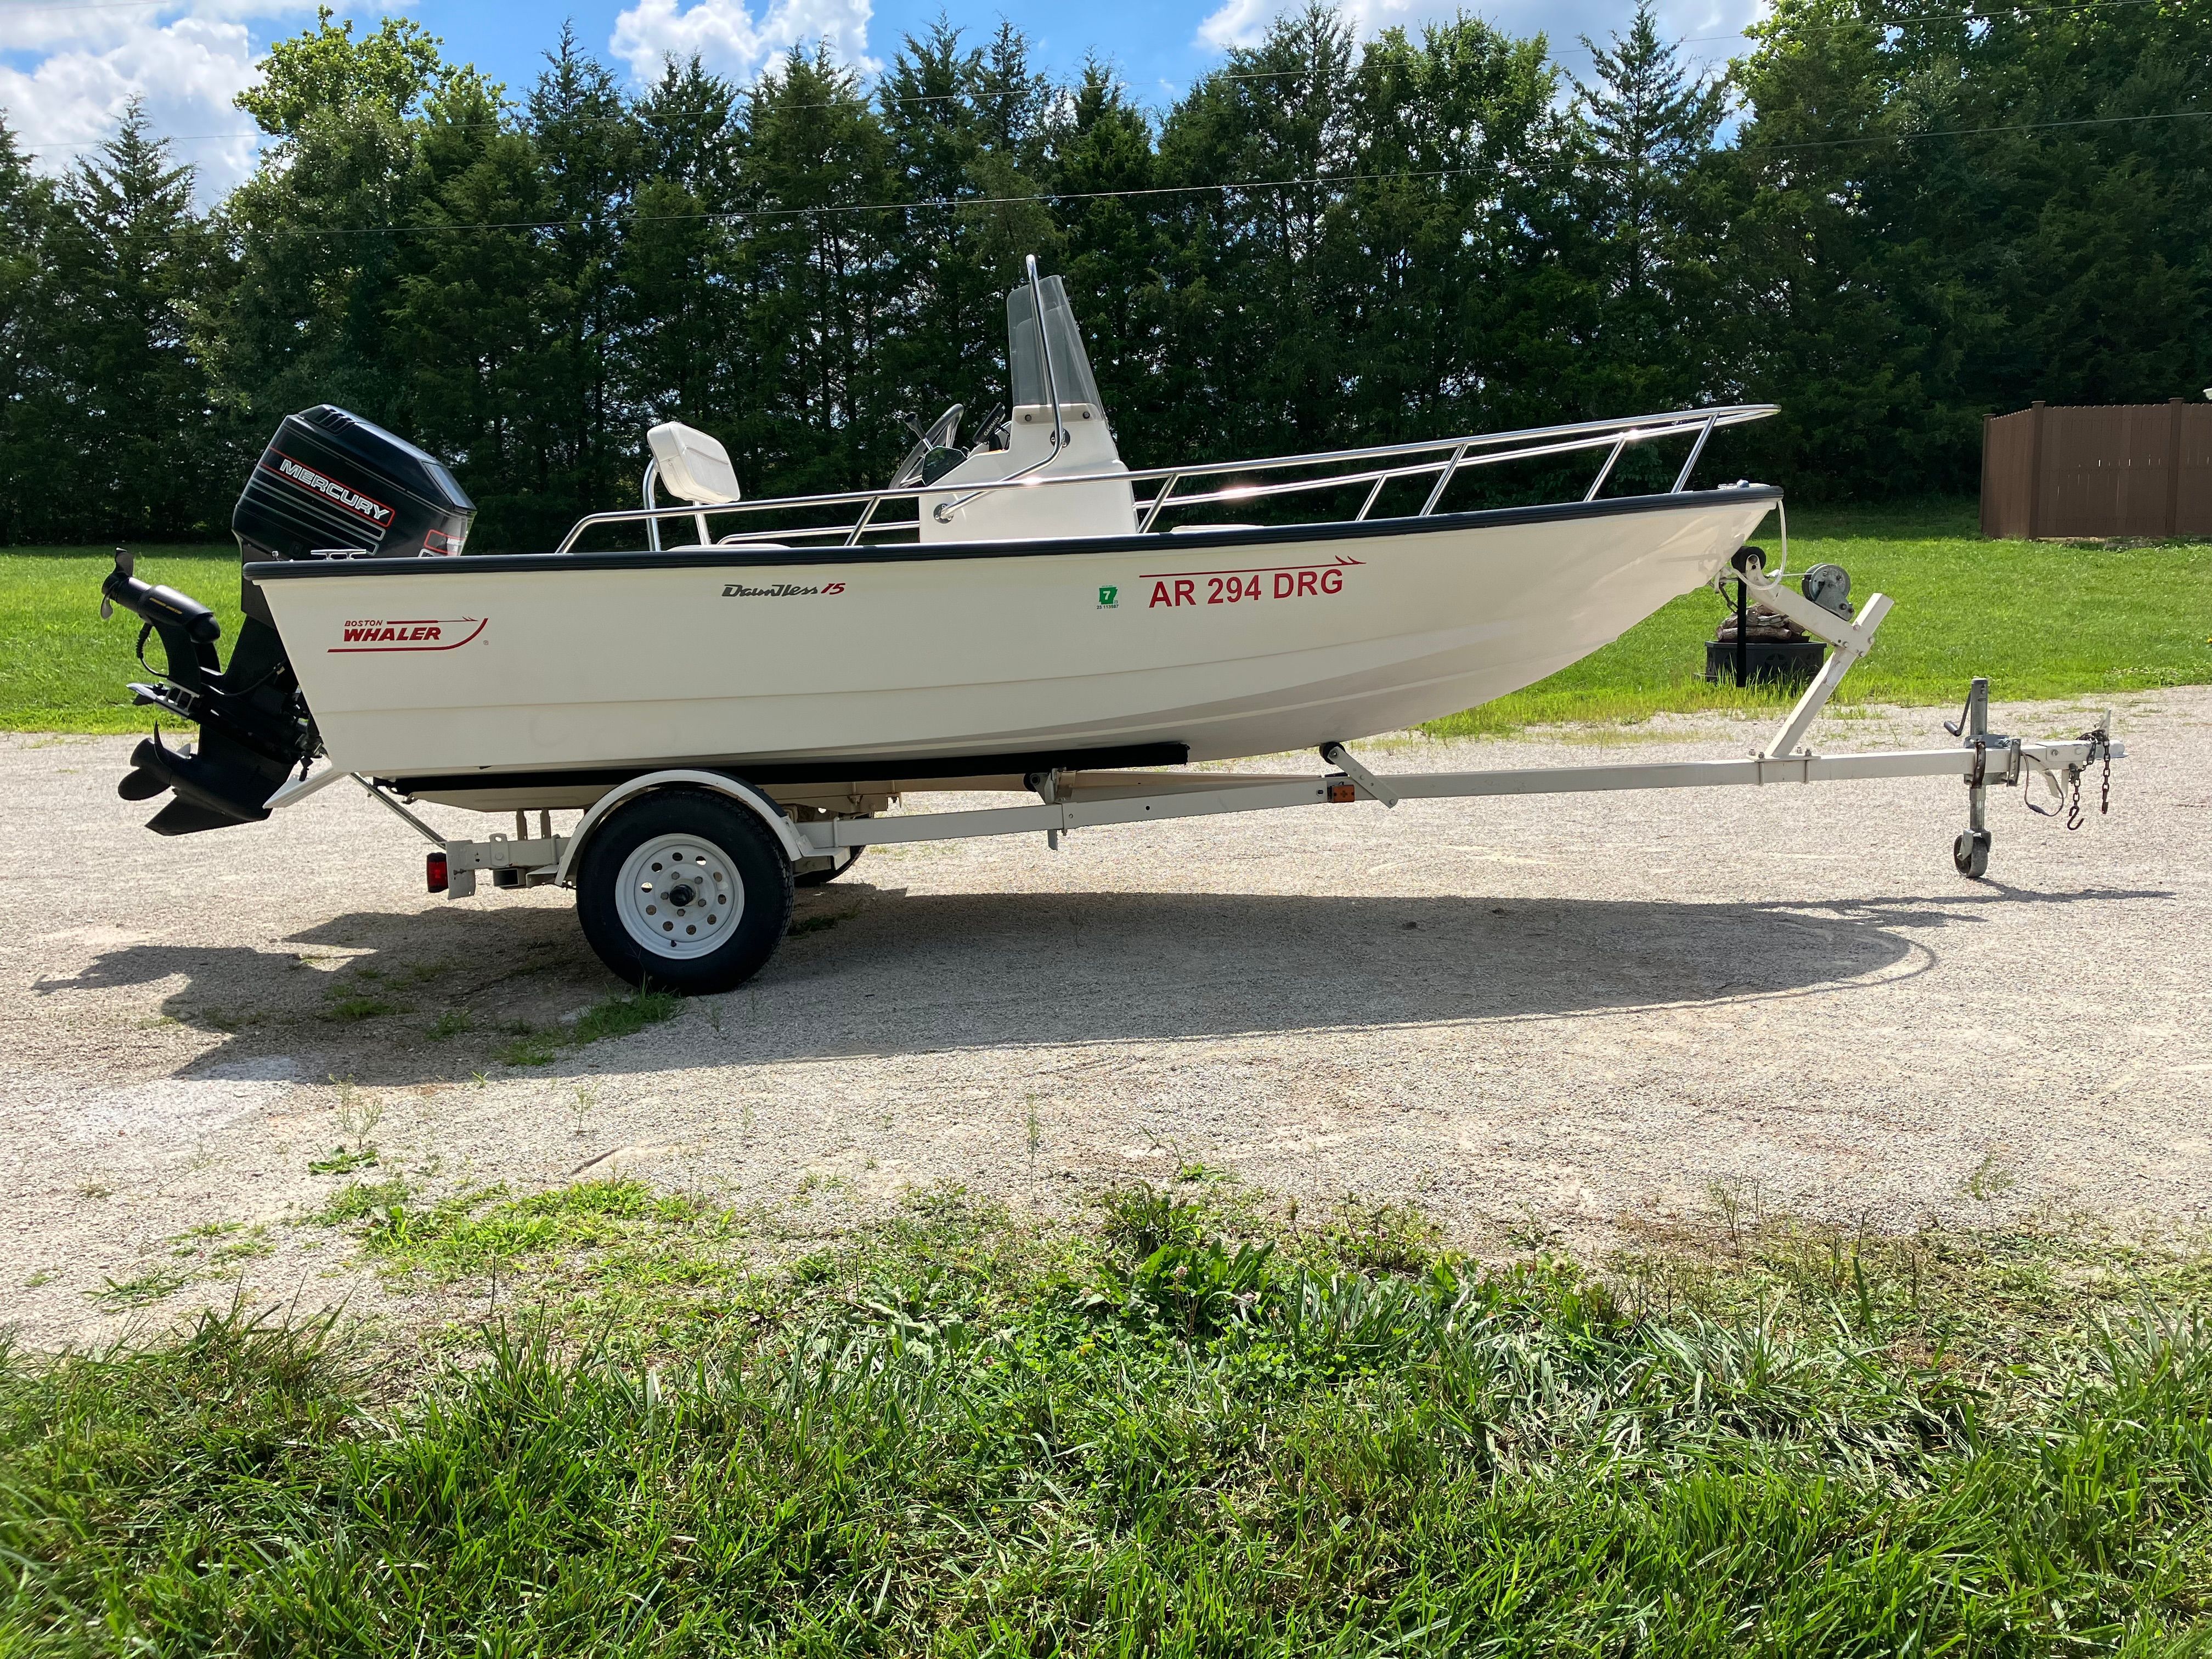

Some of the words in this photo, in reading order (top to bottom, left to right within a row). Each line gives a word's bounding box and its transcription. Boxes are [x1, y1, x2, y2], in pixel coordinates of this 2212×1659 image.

[984, 416, 1000, 436] GARMIN
[279, 459, 390, 520] MERCURY
[721, 584, 818, 597] Dauntless
[820, 583, 846, 595] 15
[1103, 590, 1111, 601] 7
[1148, 579, 1197, 608] AR
[1207, 574, 1262, 605] 294
[1273, 568, 1343, 599] DRG
[343, 627, 441, 642] WHALER
